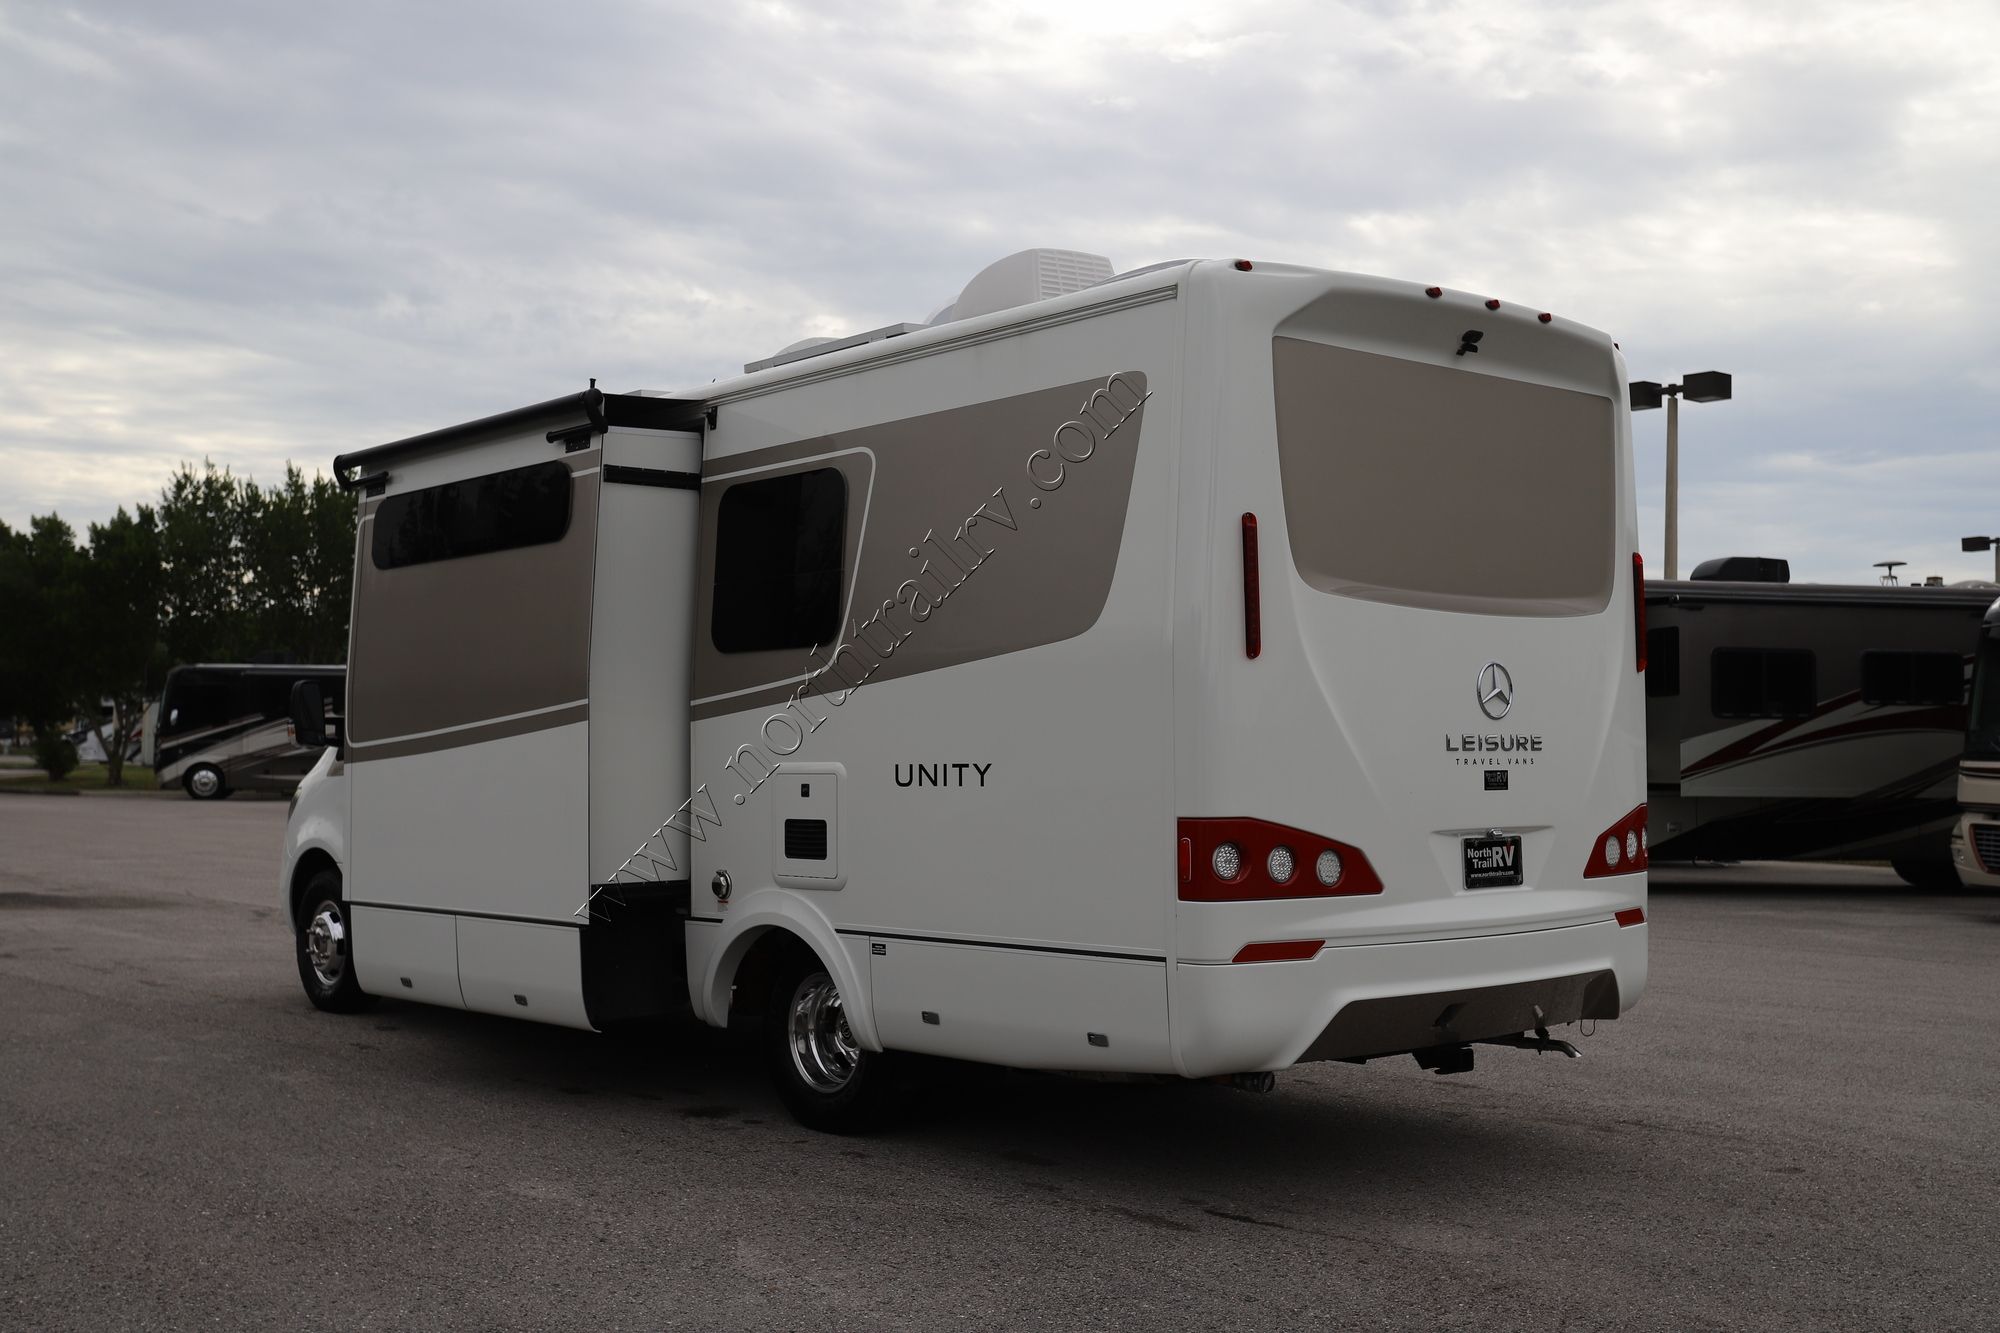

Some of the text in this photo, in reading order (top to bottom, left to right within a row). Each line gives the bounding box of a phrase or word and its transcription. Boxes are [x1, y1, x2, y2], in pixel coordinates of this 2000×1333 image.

[1445, 733, 1543, 752] LEISURE
[1455, 757, 1534, 766] TRAVEL VANS
[894, 763, 992, 787] UNITY
[1467, 847, 1492, 859] North
[1491, 845, 1515, 868] RV
[1472, 858, 1492, 869] Trail
